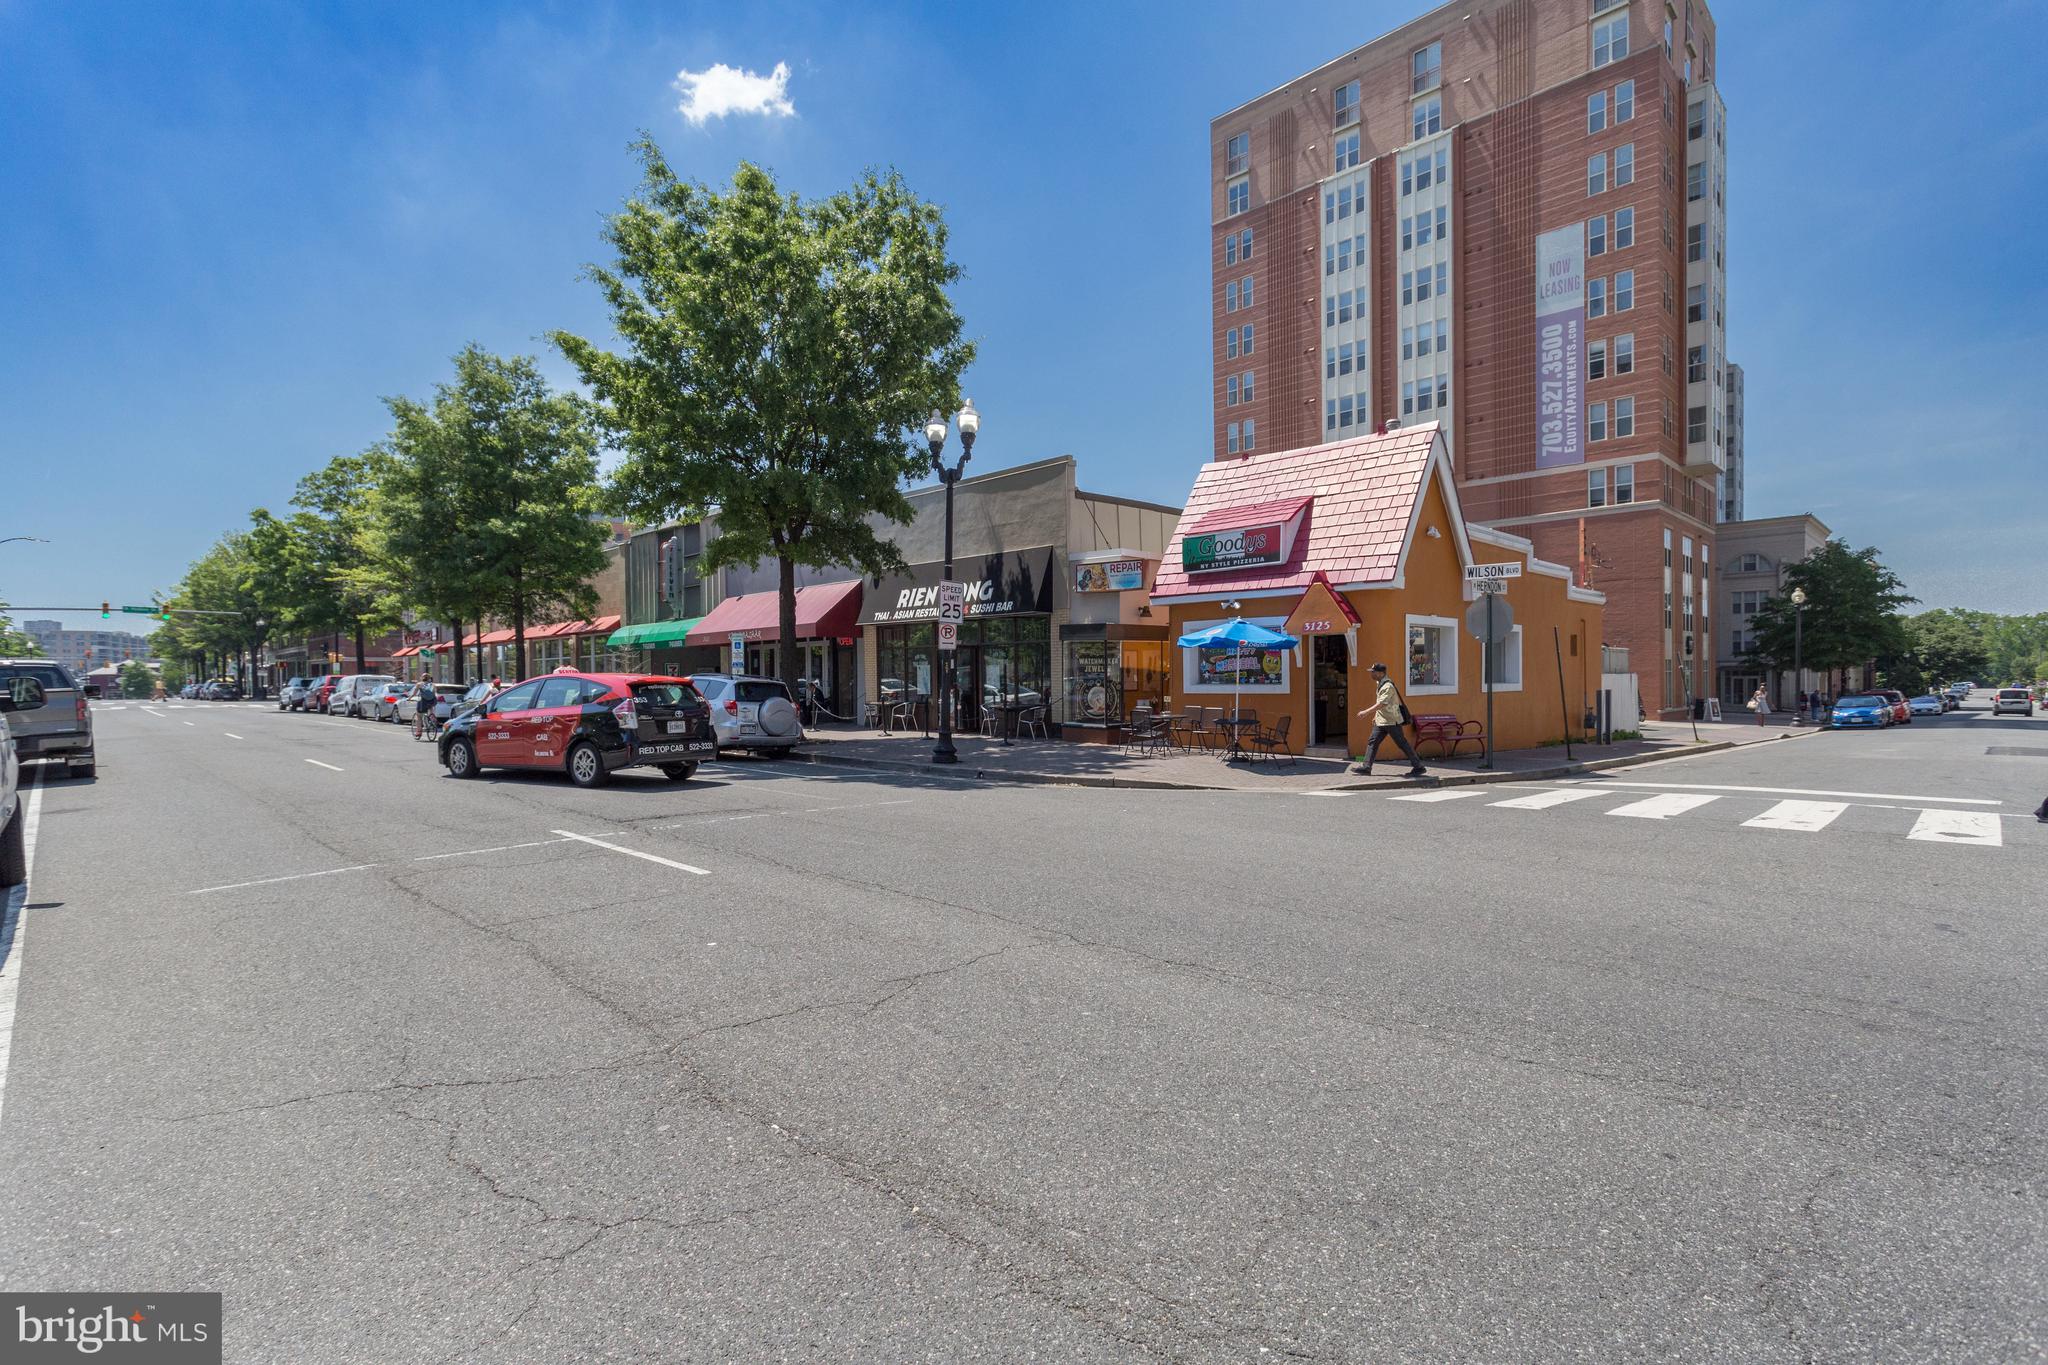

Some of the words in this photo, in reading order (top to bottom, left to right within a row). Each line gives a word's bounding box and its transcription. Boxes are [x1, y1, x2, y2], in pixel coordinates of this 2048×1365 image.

[1548, 257, 1571, 278] NOW
[1540, 274, 1581, 299] LEASING
[1541, 322, 1563, 456] 703.527.3500
[1199, 533, 1267, 555] Goodys
[1233, 556, 1265, 565] PIZZERIA
[1110, 561, 1142, 573] REPAIR
[1468, 566, 1504, 578] WILSON
[942, 585, 962, 594] SPEED
[874, 612, 890, 621] THAI
[893, 609, 916, 619] ASIAN
[970, 602, 995, 614] SUSHI
[996, 601, 1014, 612] BAR
[942, 603, 961, 619] 25
[1304, 621, 1330, 631] 3125
[1079, 657, 1119, 665] WATCHMKER
[536, 733, 548, 741] CAB
[639, 747, 655, 755] RED
[670, 744, 684, 752] CAB
[689, 742, 713, 751] 522-3333
